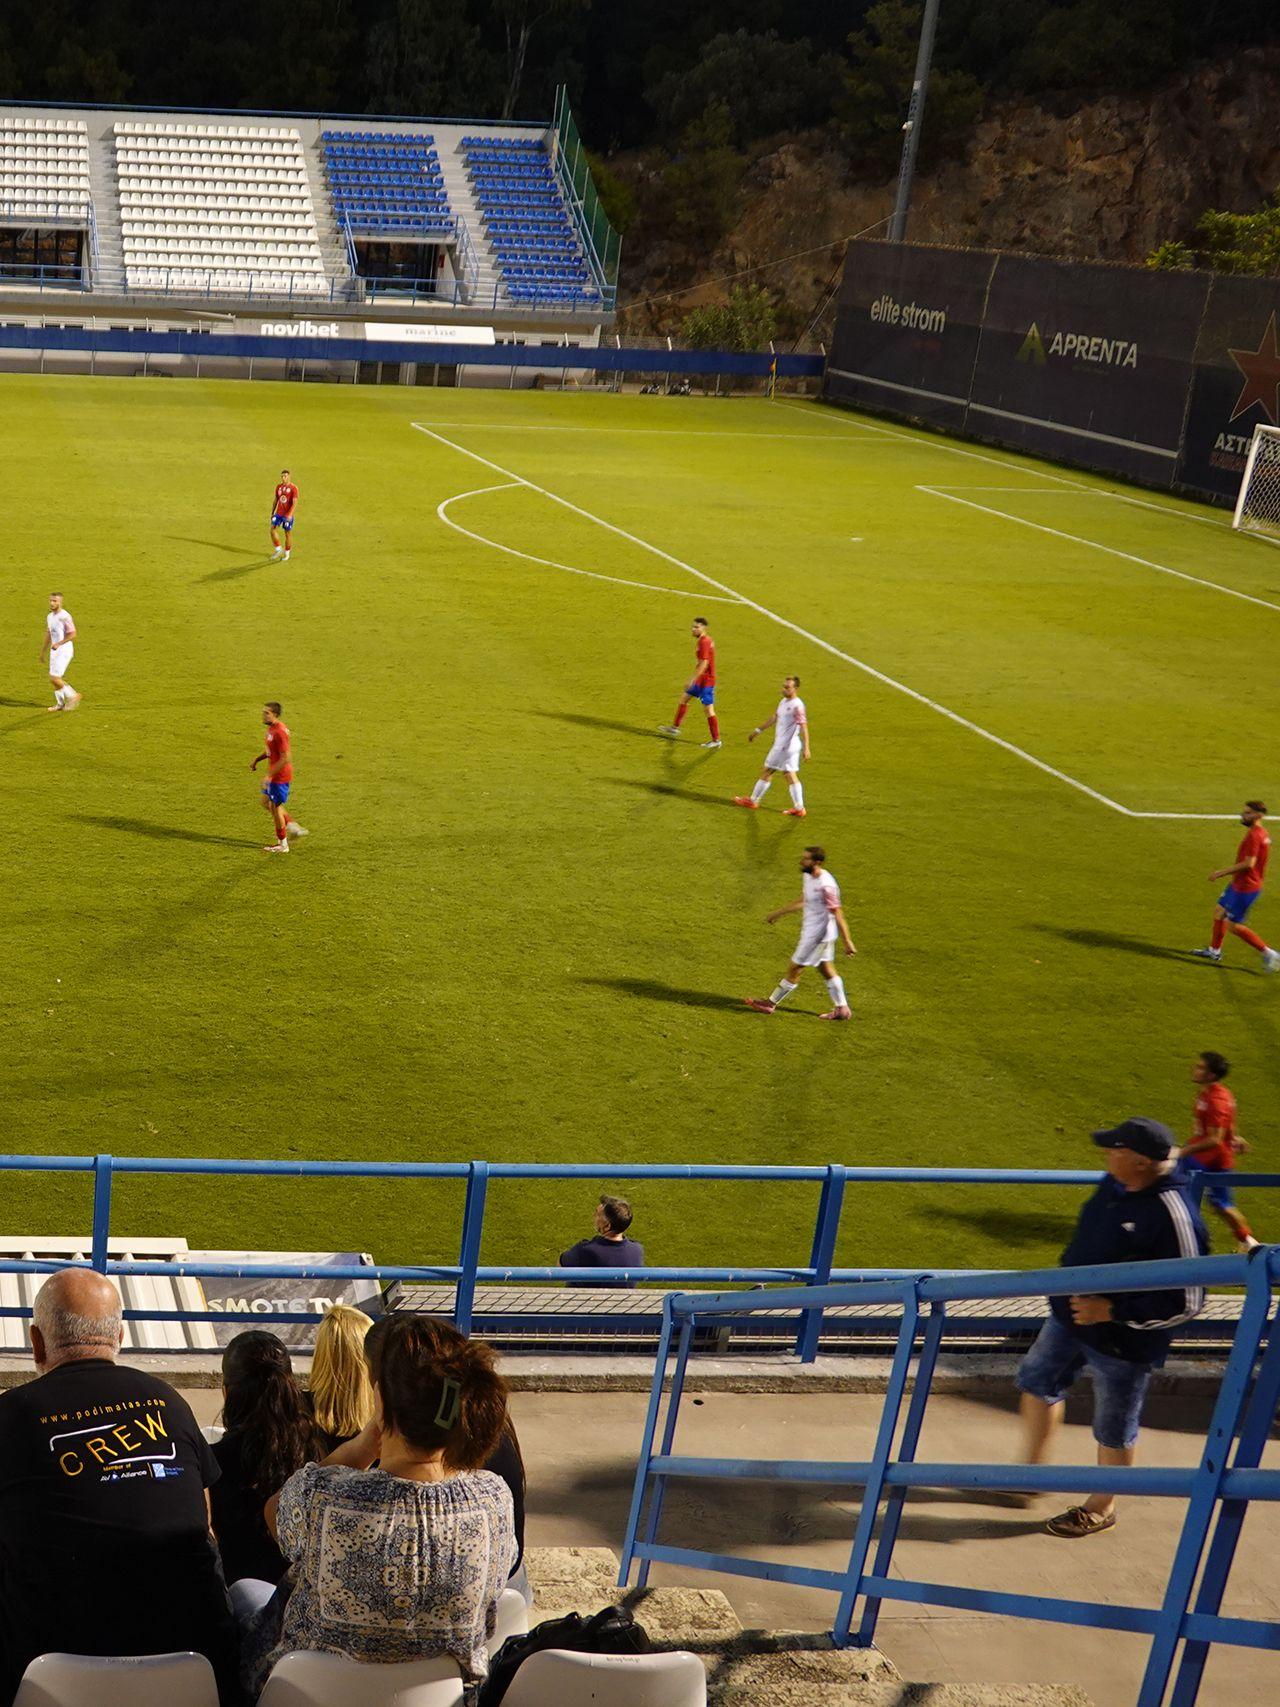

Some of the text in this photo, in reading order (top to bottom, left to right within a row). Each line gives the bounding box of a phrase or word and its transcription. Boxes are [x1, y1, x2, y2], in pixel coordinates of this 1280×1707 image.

[261, 321, 339, 336] novibet
[871, 294, 946, 333] elite strom
[1048, 332, 1137, 369] APRENTA
[59, 1410, 168, 1476] CREW
